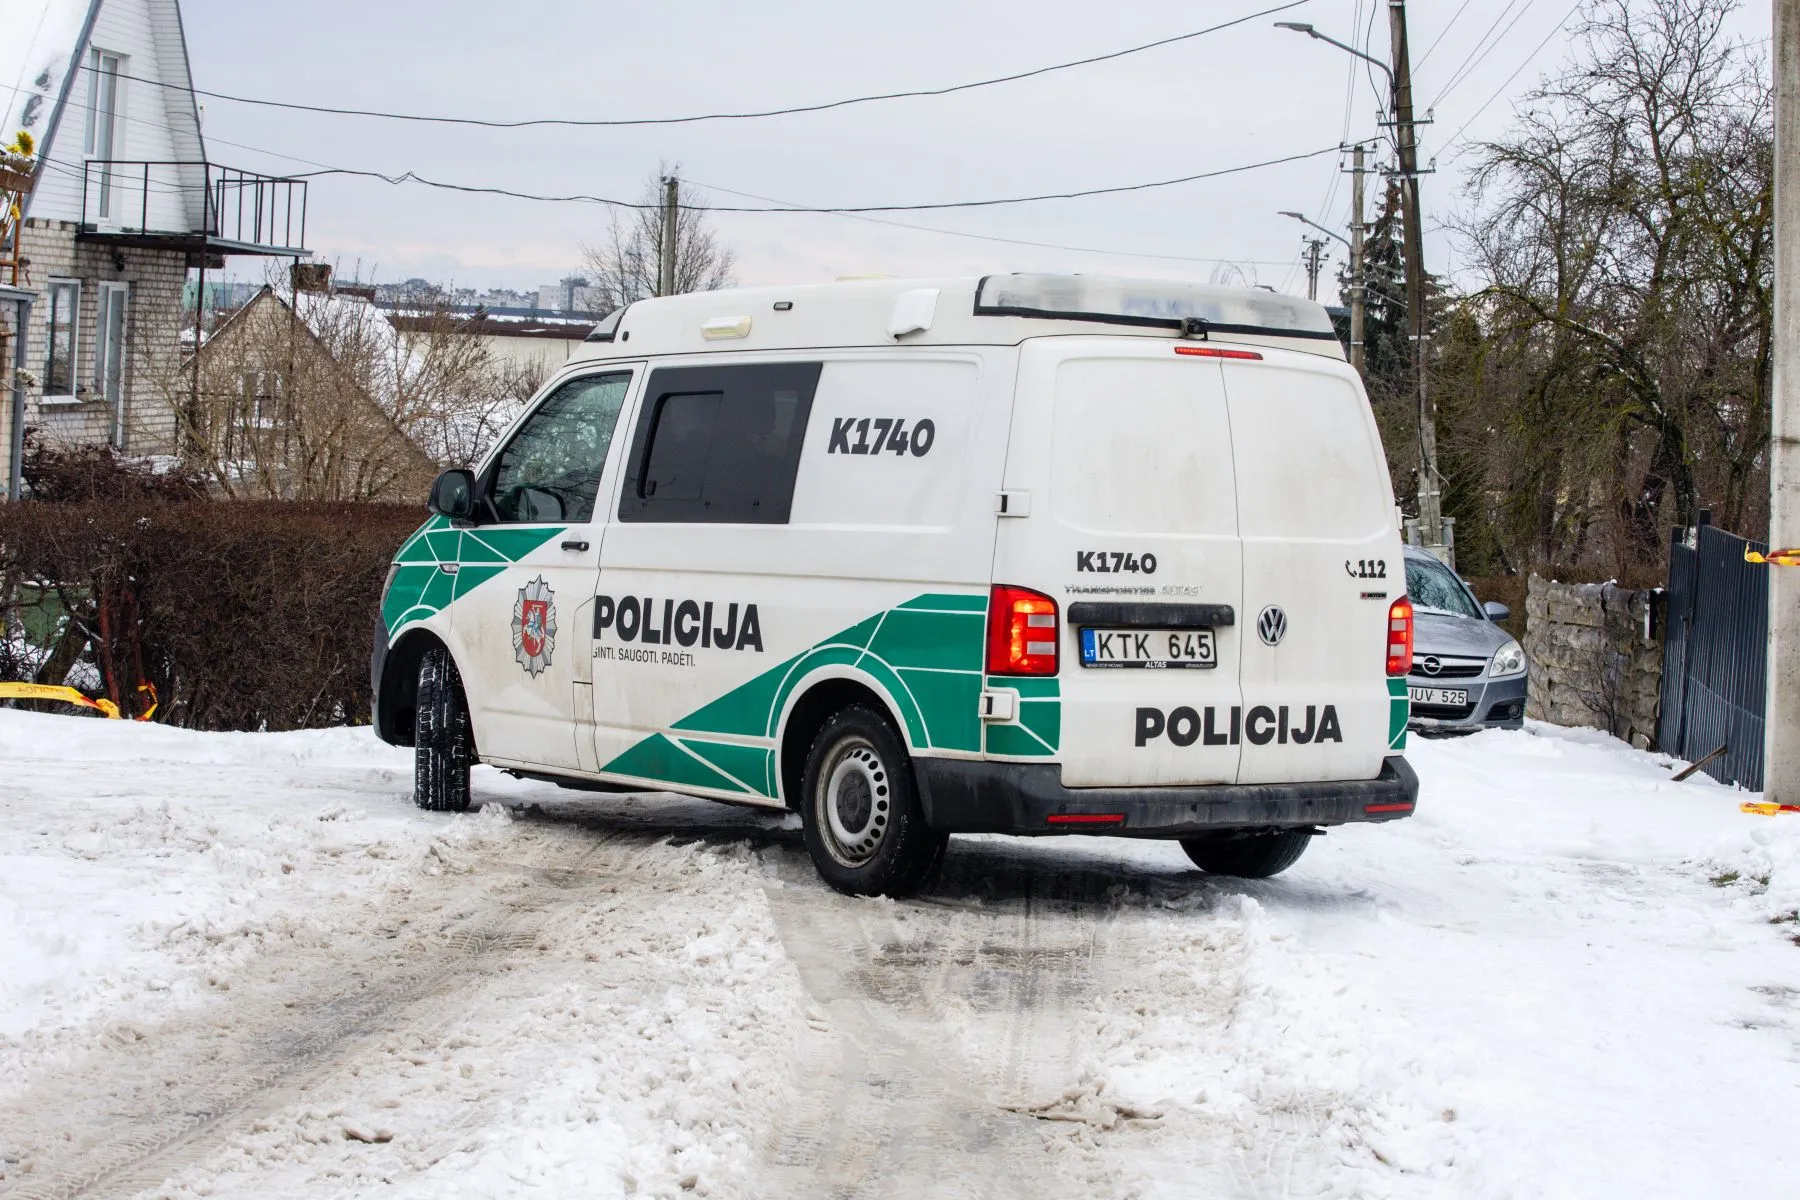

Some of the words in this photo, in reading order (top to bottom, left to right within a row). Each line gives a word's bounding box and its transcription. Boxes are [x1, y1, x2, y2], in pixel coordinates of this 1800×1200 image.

[828, 417, 936, 458] K1740
[1077, 551, 1157, 574] K1740
[1358, 560, 1386, 578] 112
[593, 595, 764, 652] POLICIJA
[618, 647, 659, 664] SAUGOTI.
[661, 650, 696, 667] PADĖTI.
[1085, 649, 1095, 658] LT
[1098, 633, 1151, 659] KTK
[1168, 633, 1211, 660] 645
[1145, 661, 1167, 669] ALTAS
[1441, 691, 1465, 704] 525
[1135, 705, 1343, 747] POLICIJA
